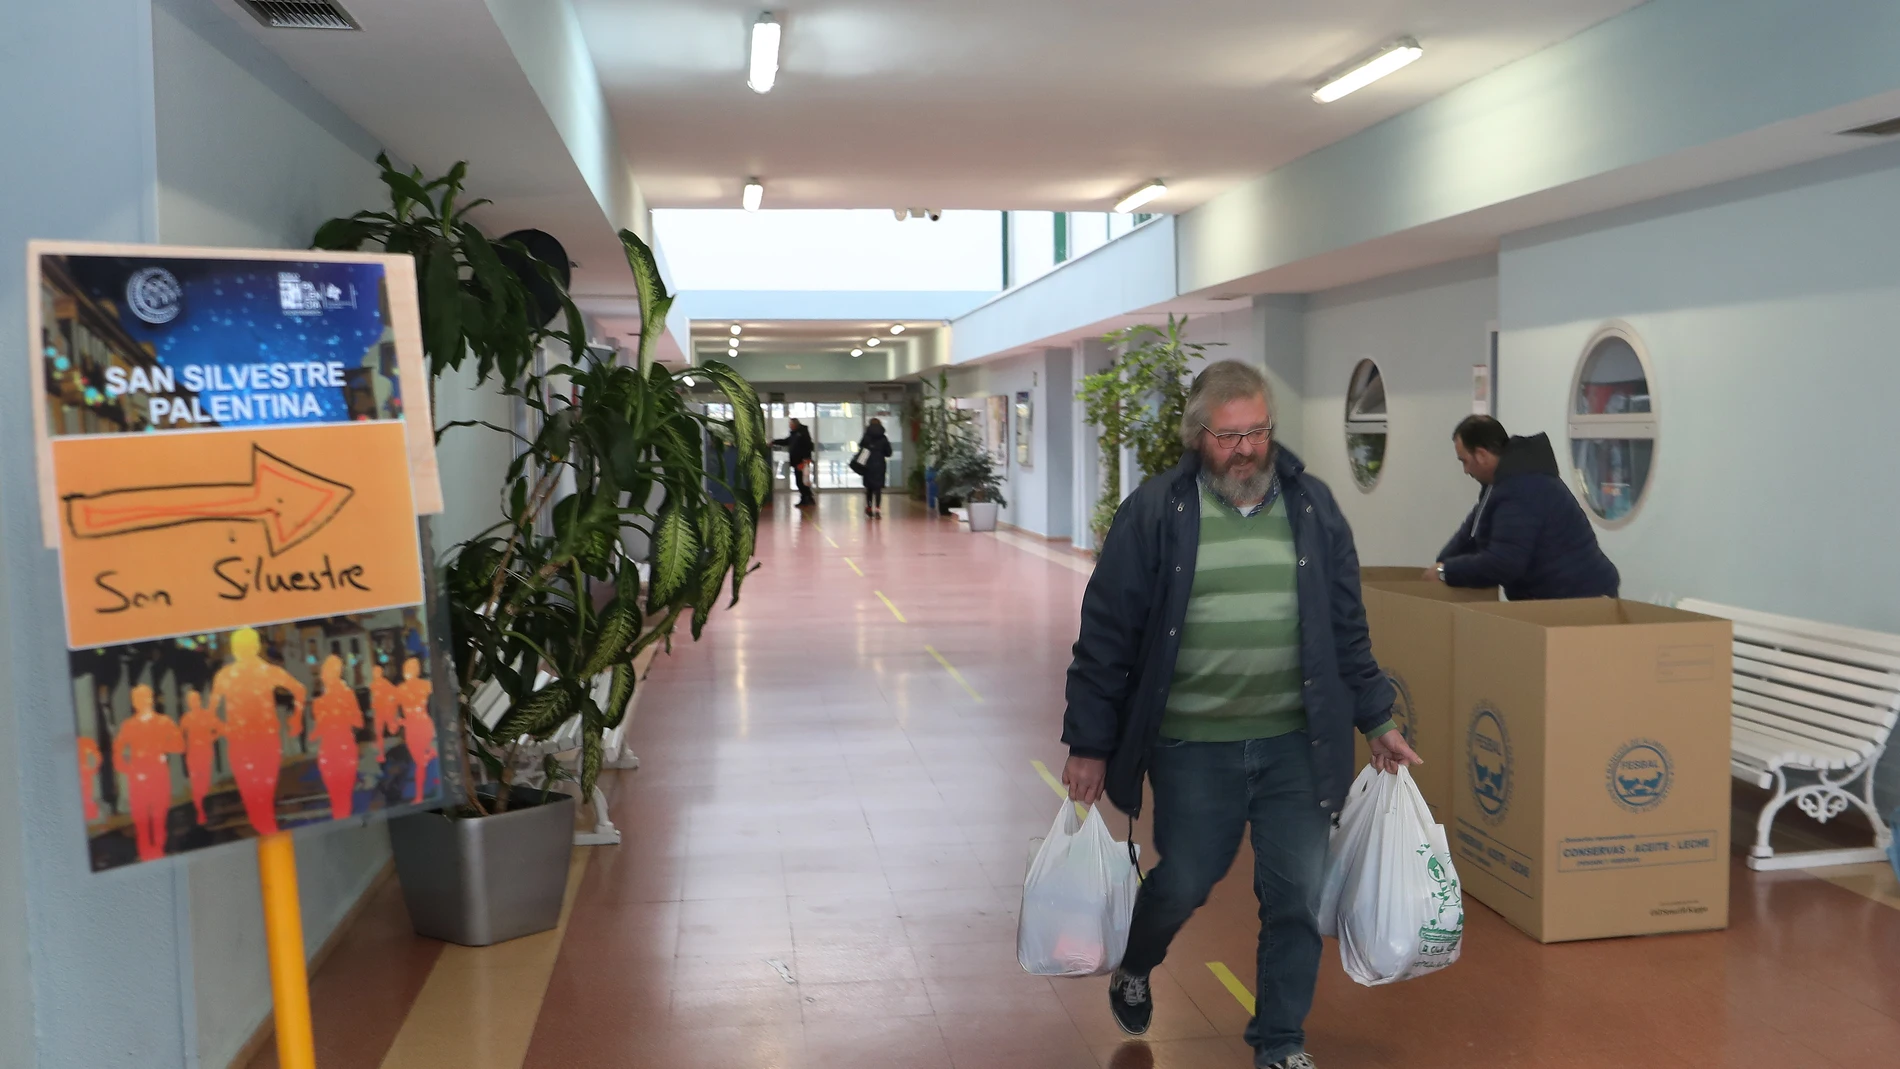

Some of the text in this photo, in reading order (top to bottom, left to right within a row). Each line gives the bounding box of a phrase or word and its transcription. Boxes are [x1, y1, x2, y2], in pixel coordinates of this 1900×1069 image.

[105, 361, 348, 396] SAN SILVESTRE
[148, 393, 323, 425] PALENTINA
[95, 571, 174, 613] San
[1563, 845, 1626, 858] CONSERVAS
[1634, 841, 1670, 853] ACEITE
[1678, 838, 1710, 850] LECHE
